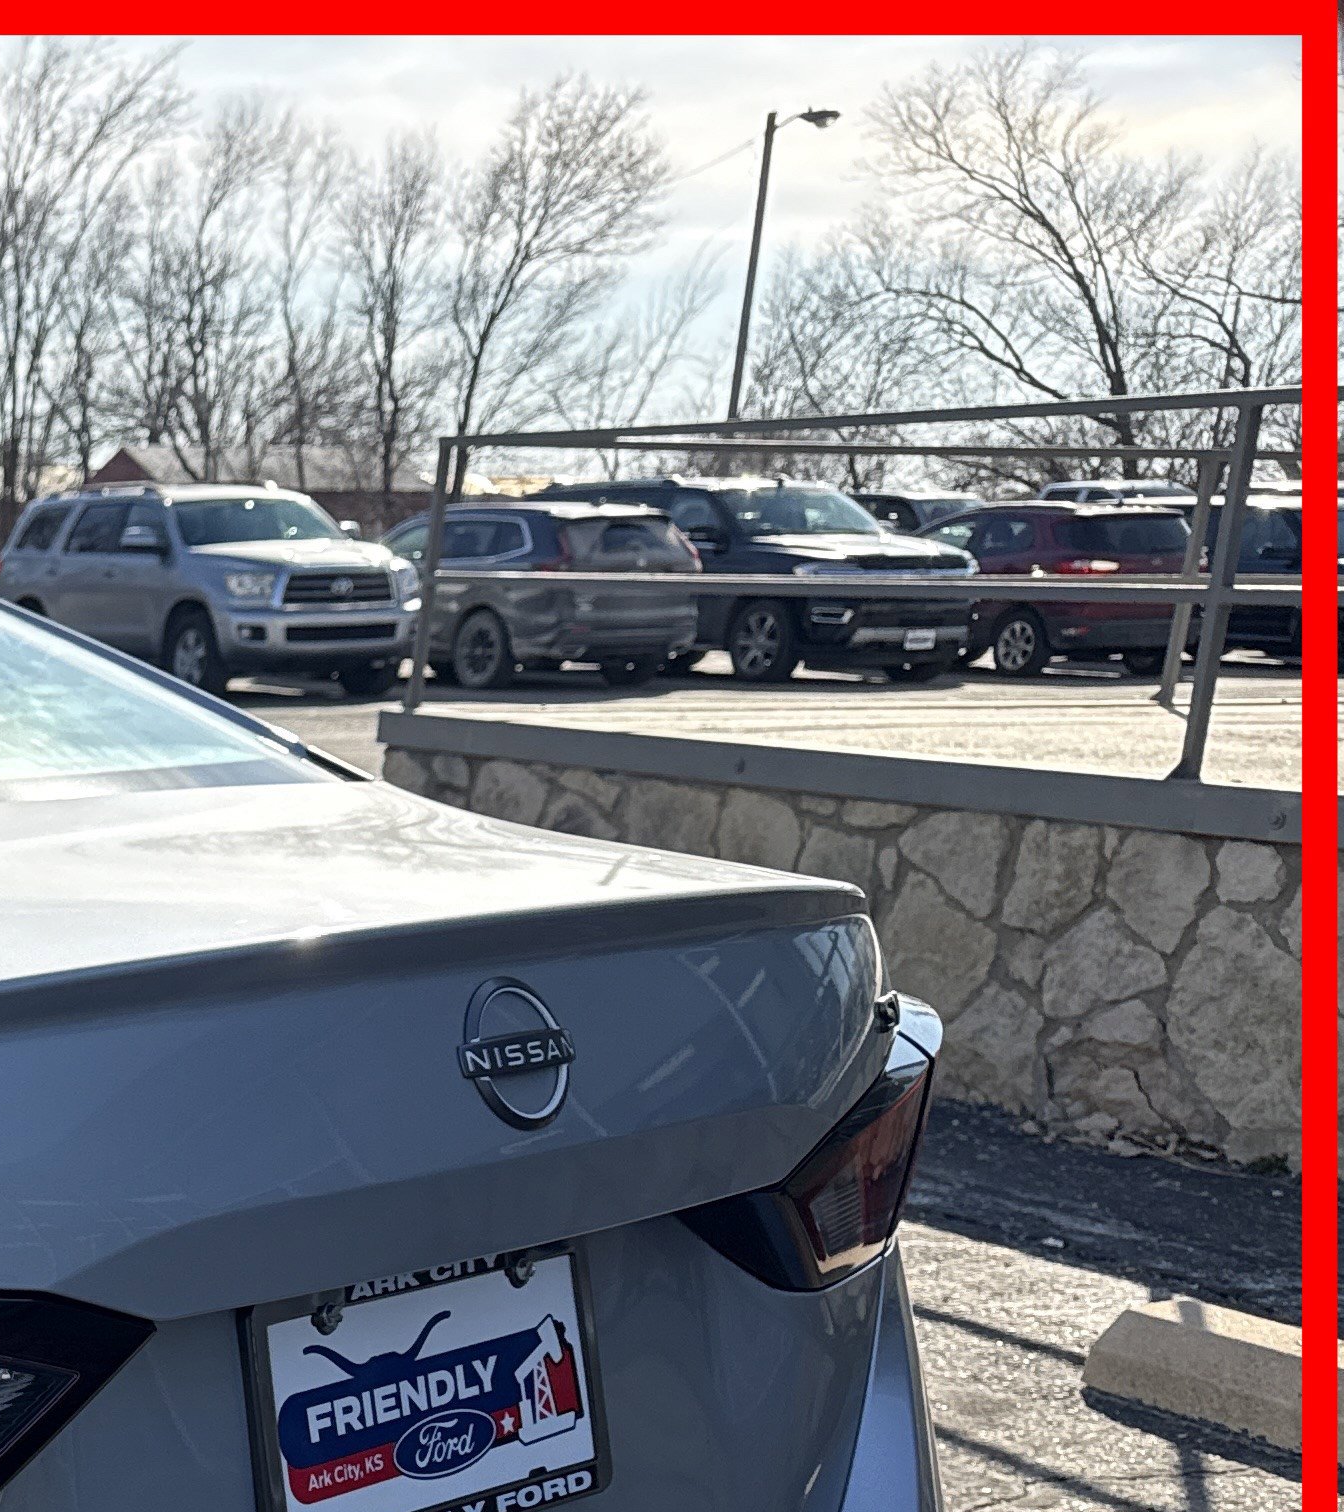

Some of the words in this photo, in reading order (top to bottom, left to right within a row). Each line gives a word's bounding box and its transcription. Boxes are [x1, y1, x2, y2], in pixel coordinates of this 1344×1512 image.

[465, 1036, 574, 1072] NISSAN
[350, 1271, 420, 1300] ARK
[429, 1253, 498, 1281] CITY
[306, 1355, 498, 1444] FRIENDLY
[415, 1418, 475, 1468] Ford
[308, 1469, 333, 1492] Ark
[333, 1463, 365, 1484] City,
[364, 1453, 384, 1474] KS
